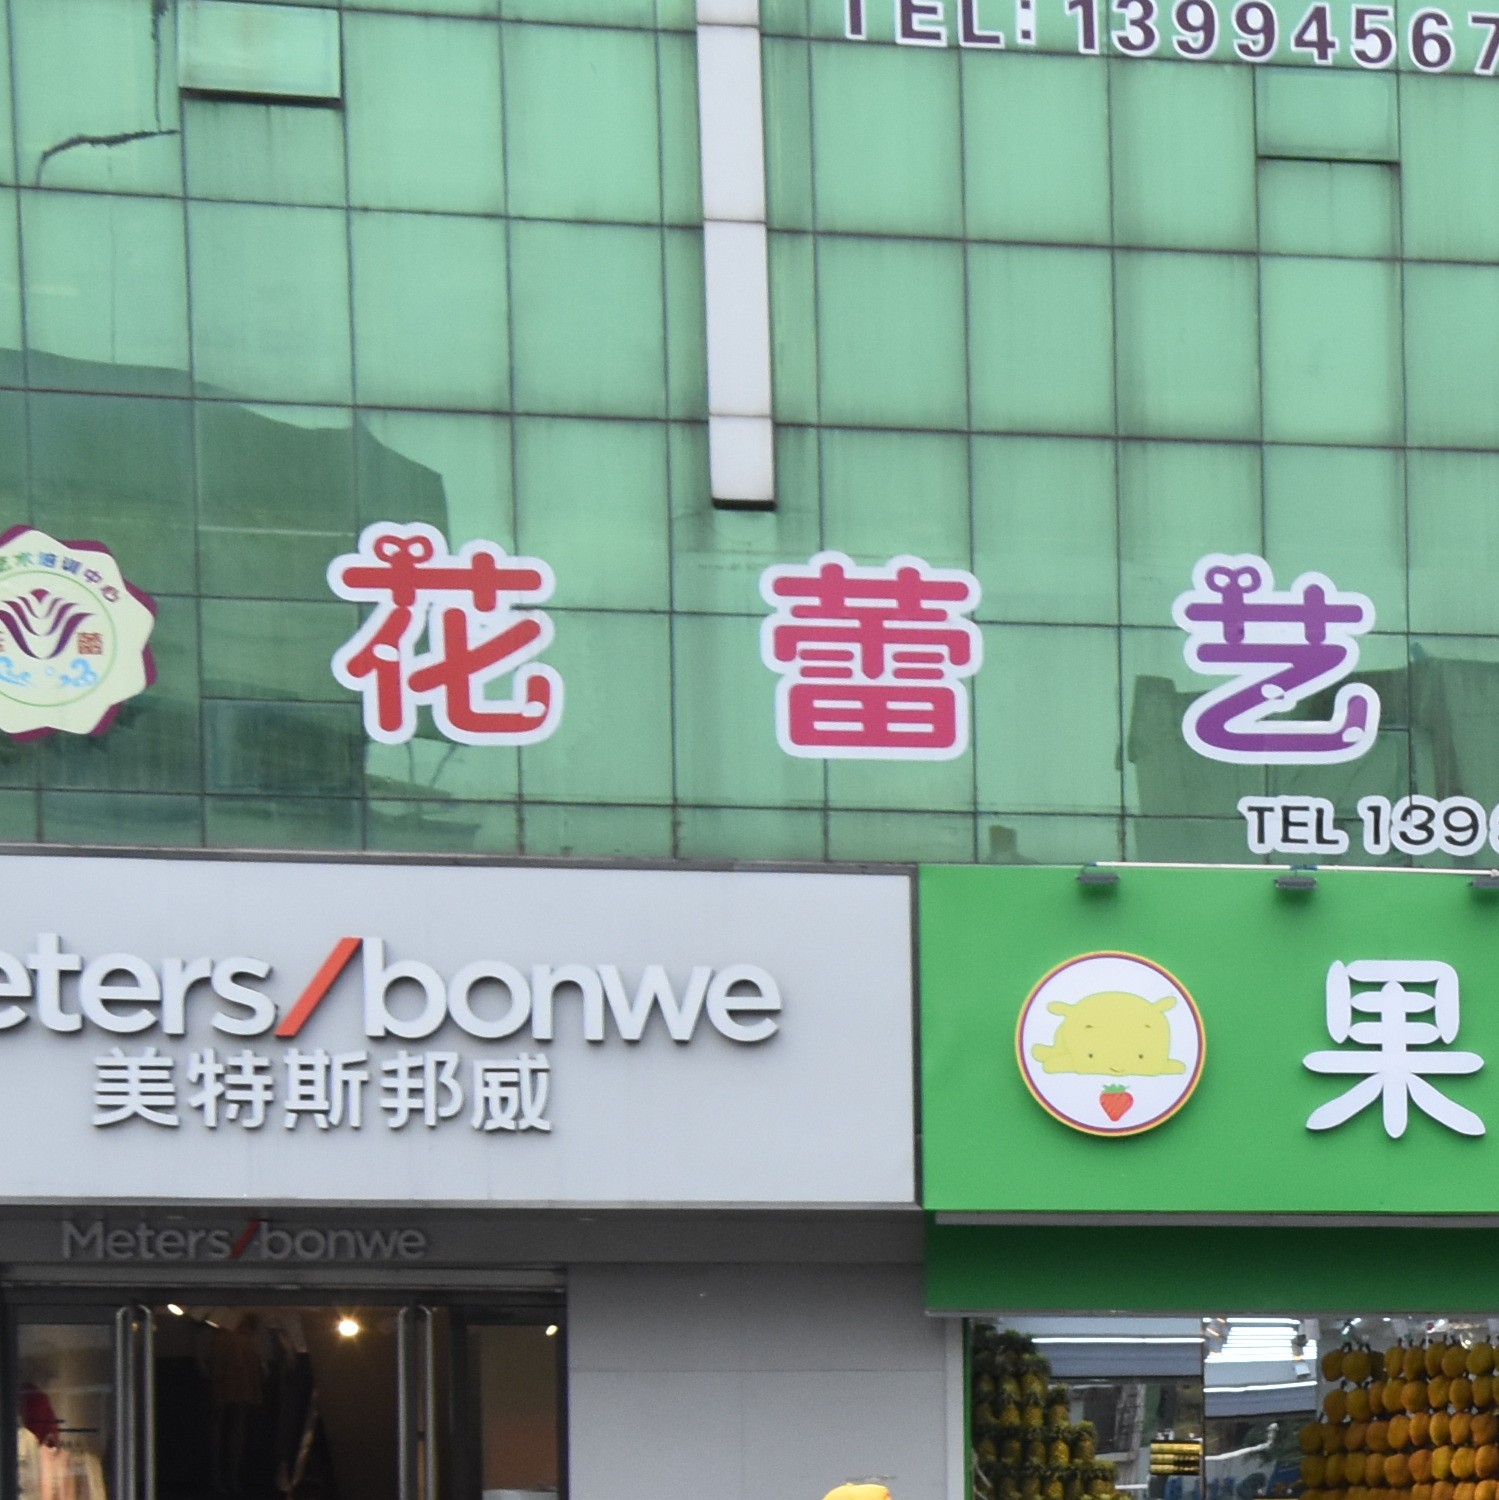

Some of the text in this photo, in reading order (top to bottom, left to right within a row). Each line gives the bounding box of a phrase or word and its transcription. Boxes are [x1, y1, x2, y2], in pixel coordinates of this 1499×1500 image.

[1247, 804, 1341, 848] TEL
[92, 1047, 553, 1132] 美特斯邦威
[61, 1219, 427, 1262] Meters/bonwe
